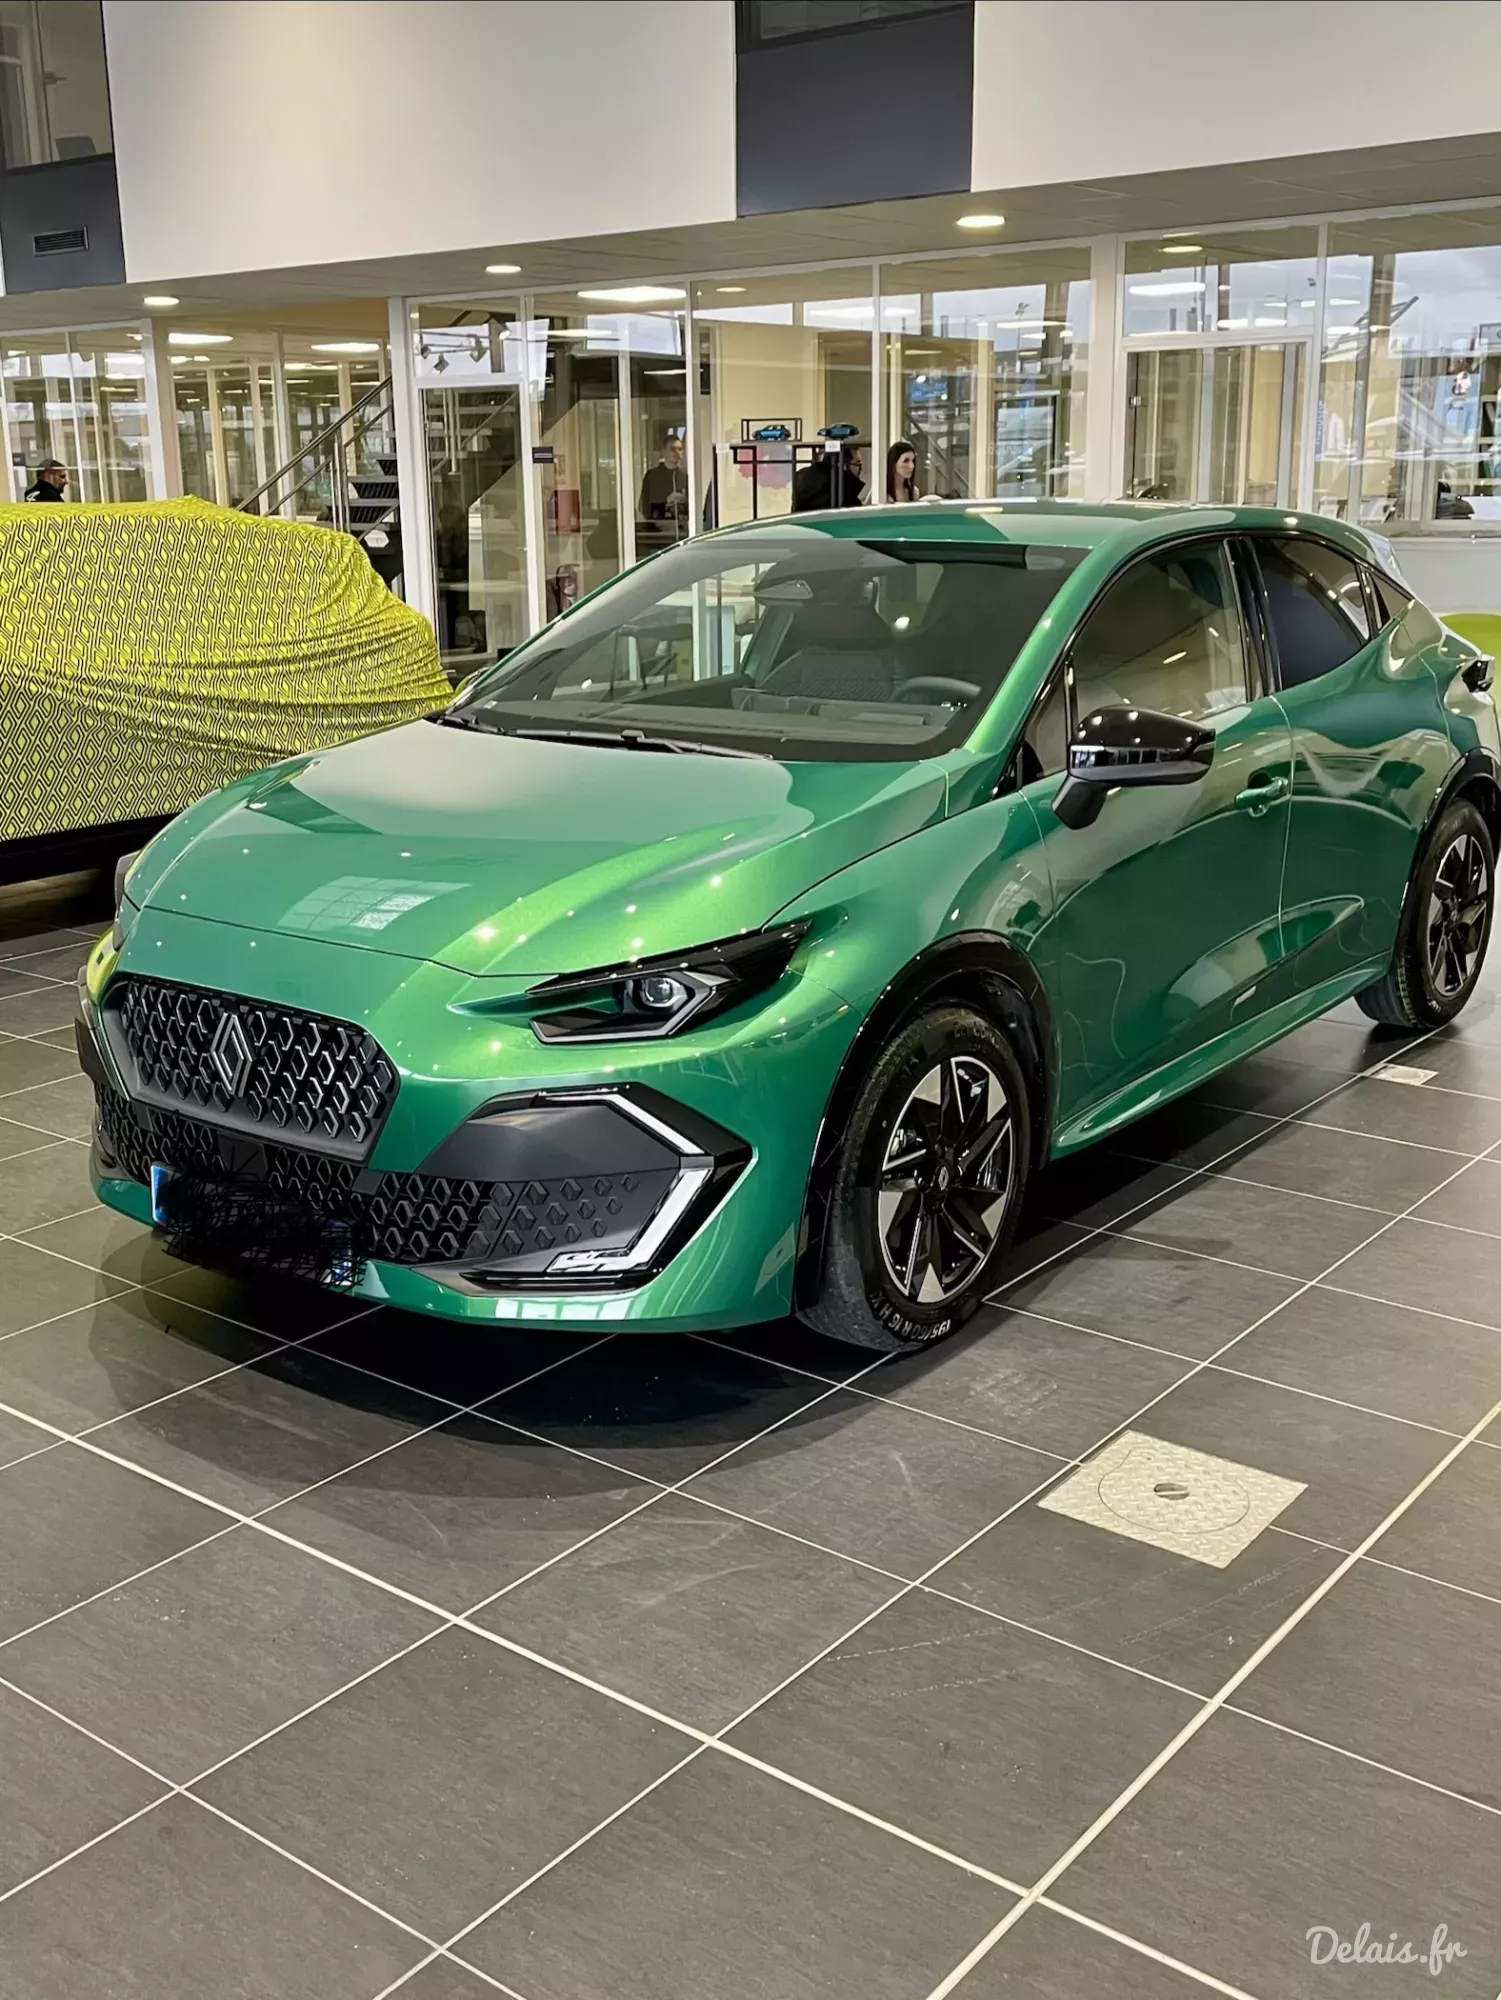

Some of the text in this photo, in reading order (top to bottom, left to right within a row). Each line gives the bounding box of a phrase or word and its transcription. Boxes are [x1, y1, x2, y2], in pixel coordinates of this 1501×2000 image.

[888, 1312, 904, 1332] 16
[901, 1320, 913, 1336] R
[910, 1318, 951, 1340] 195/60
